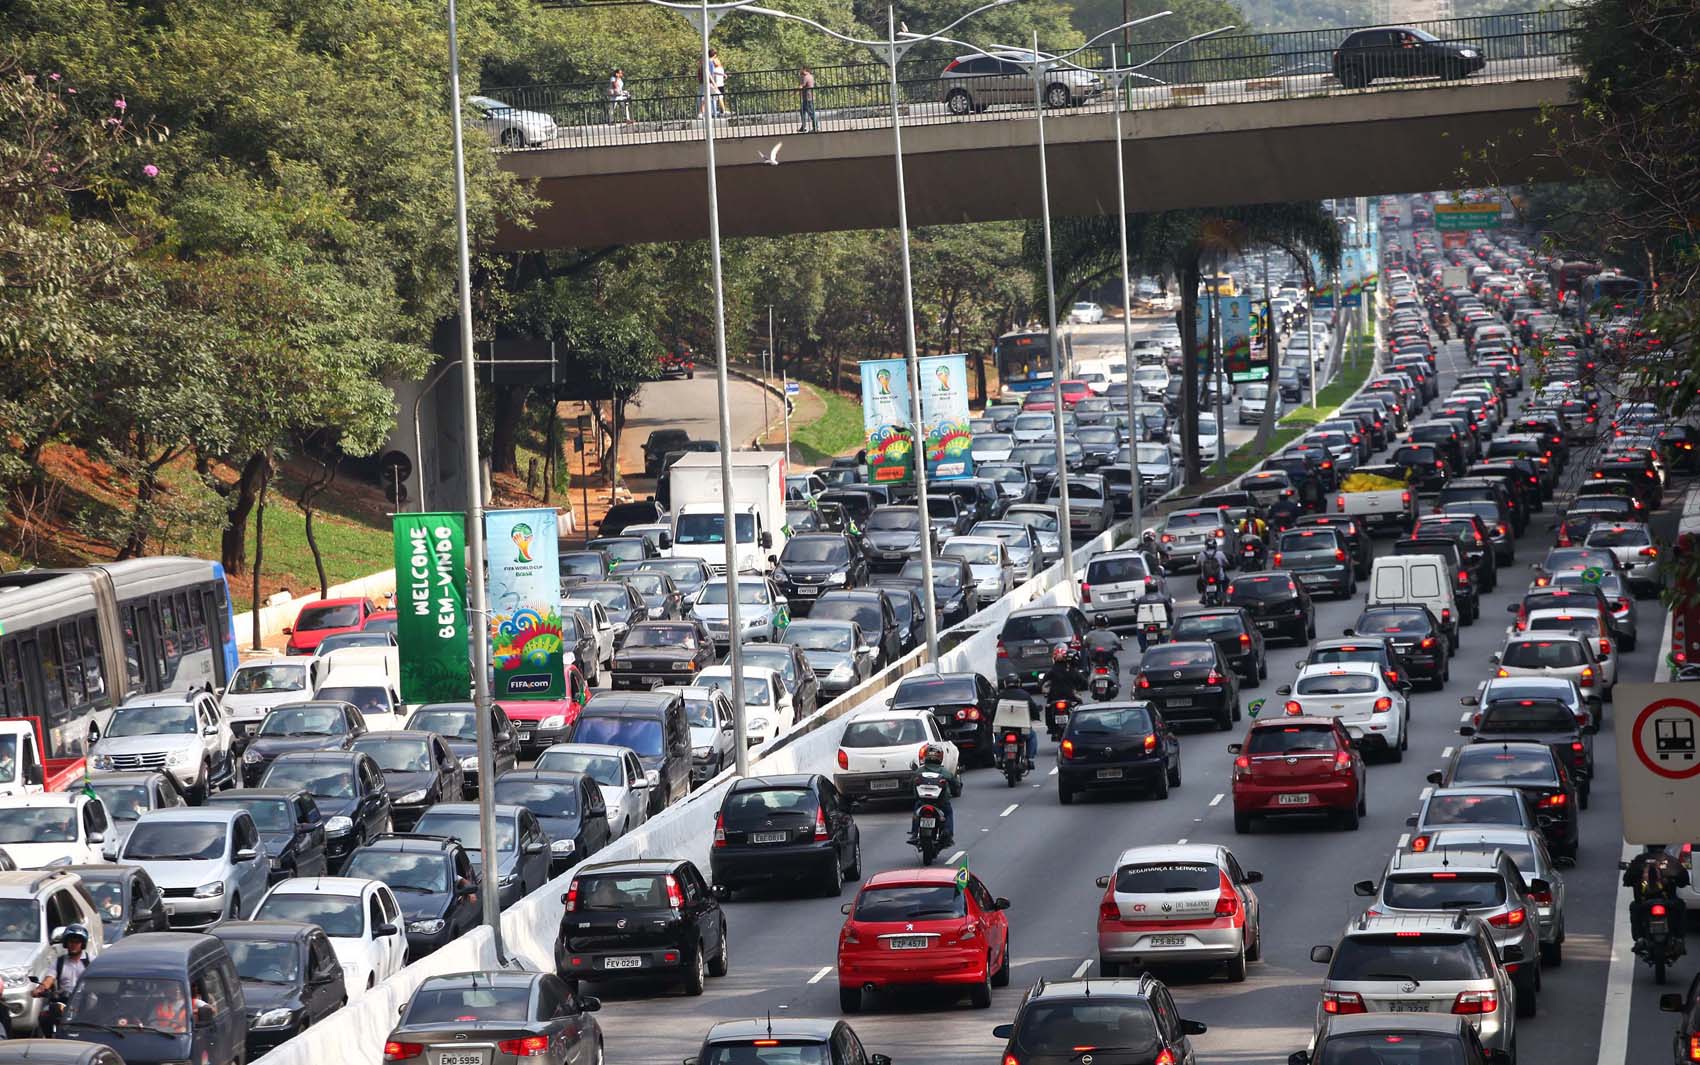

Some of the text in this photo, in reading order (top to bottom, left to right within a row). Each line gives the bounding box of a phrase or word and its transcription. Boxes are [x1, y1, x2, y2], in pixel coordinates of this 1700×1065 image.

[410, 526, 430, 615] WELCOME
[435, 526, 456, 638] BEM-VINDO
[510, 680, 549, 689] FIFA.com
[1128, 866, 1168, 875] SEGURANÇA
